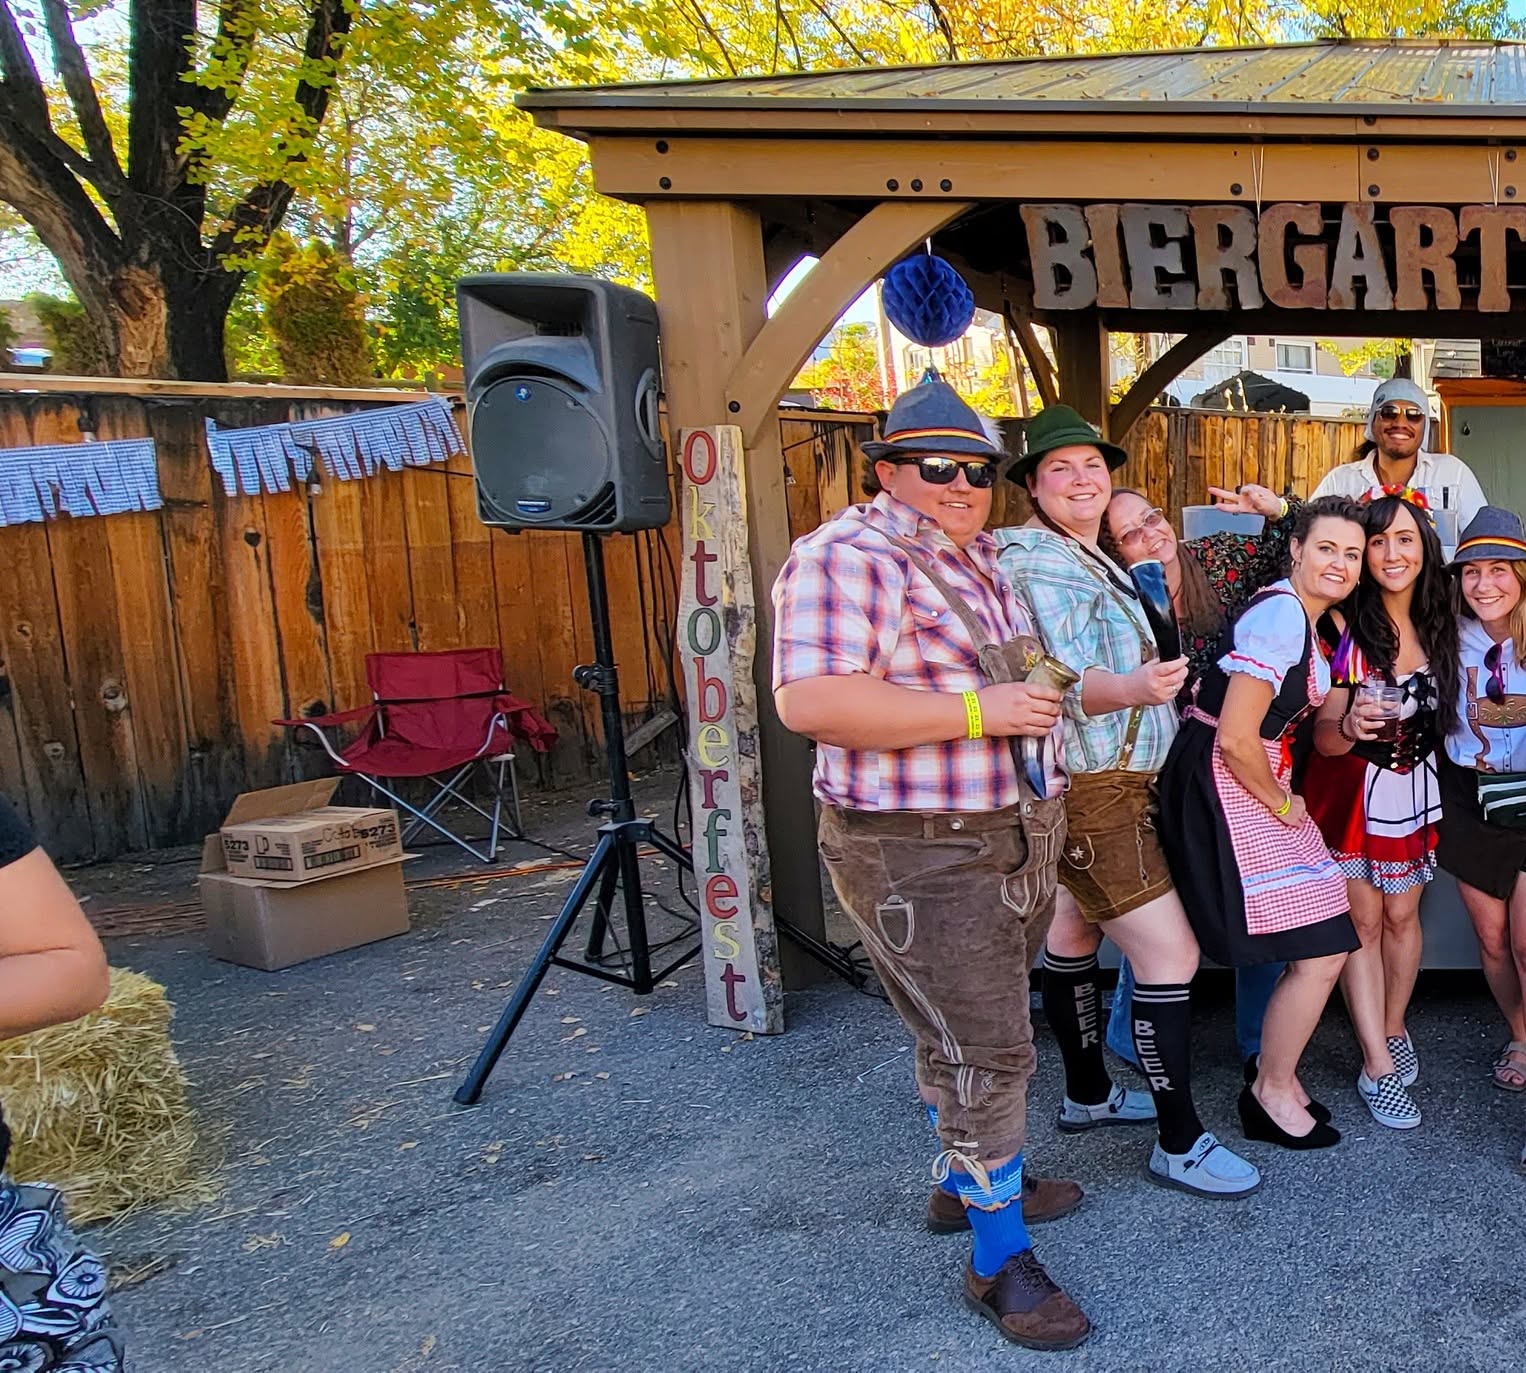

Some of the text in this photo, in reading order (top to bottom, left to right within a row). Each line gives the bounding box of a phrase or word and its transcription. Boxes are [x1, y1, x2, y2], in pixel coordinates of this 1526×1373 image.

[683, 430, 748, 1022] Oktoberfest
[1073, 982, 1099, 1049] BEER
[1134, 1019, 1176, 1092] BEER
